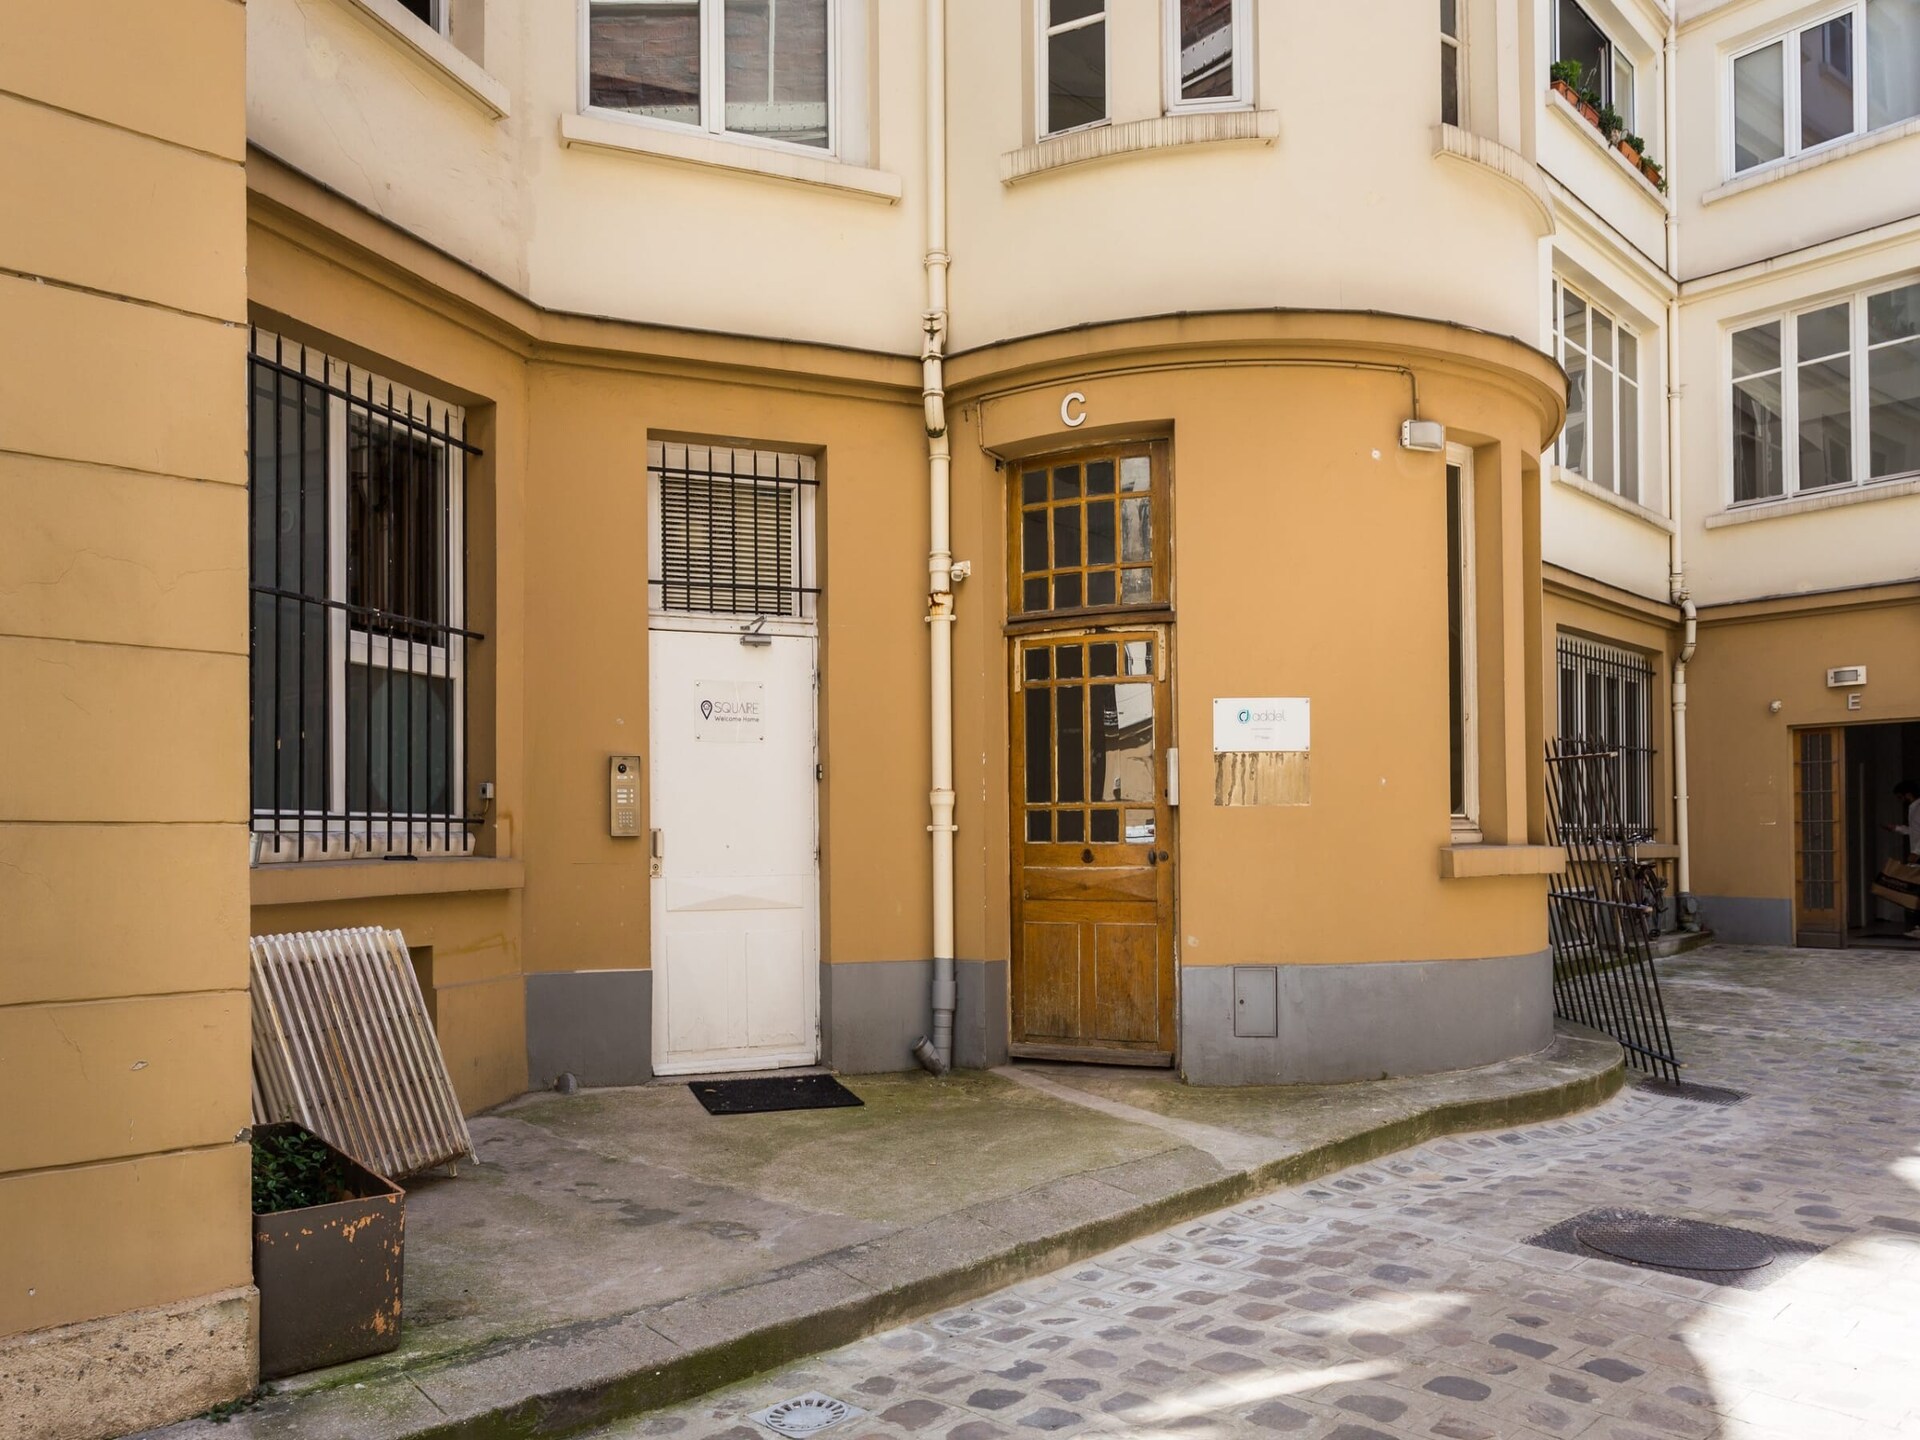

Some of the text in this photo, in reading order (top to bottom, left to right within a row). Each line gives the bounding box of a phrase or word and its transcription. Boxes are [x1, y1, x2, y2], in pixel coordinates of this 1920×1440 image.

[1061, 391, 1087, 427] C
[714, 701, 759, 714] SQUARE
[1848, 693, 1861, 710] E
